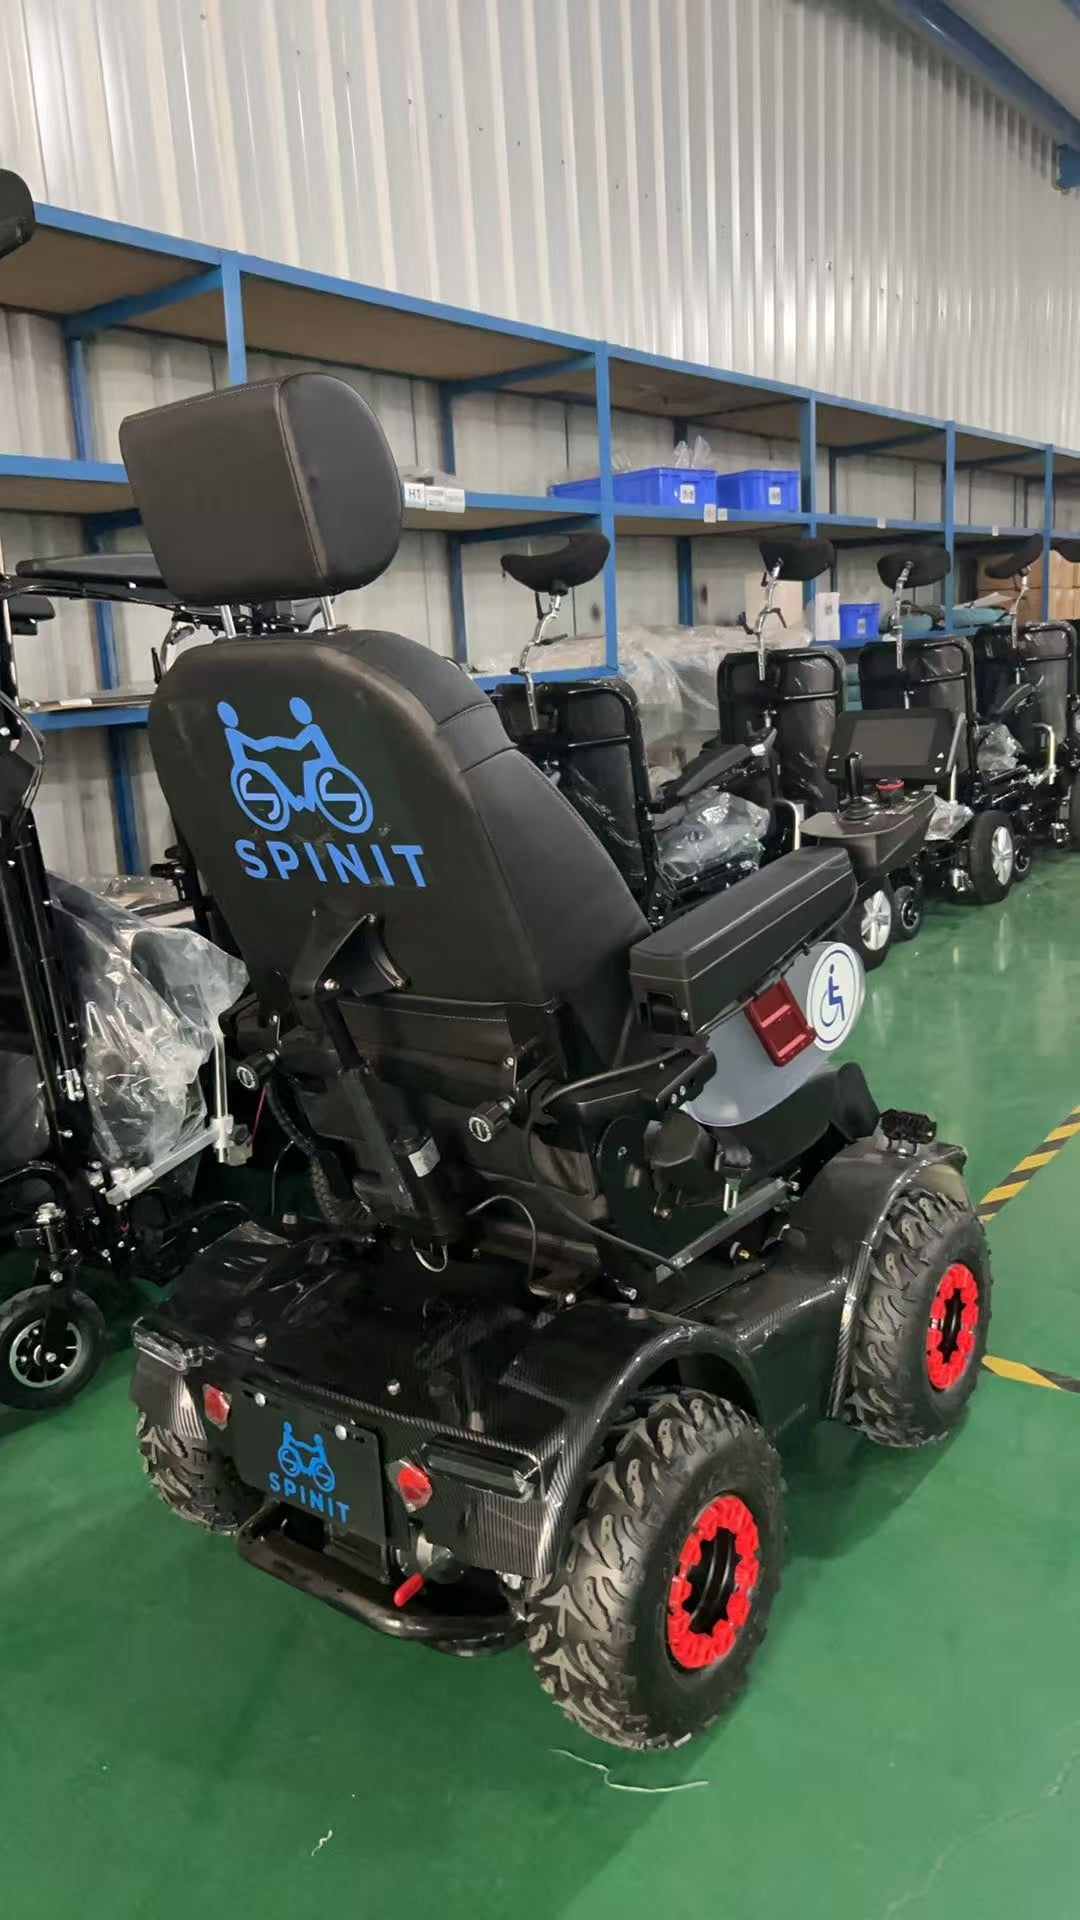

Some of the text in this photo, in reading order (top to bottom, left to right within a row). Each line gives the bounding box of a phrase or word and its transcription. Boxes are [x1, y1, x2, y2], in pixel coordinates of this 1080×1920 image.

[408, 488, 421, 501] H1
[235, 839, 427, 888] SPINIT
[269, 1472, 350, 1523] SPINIT
